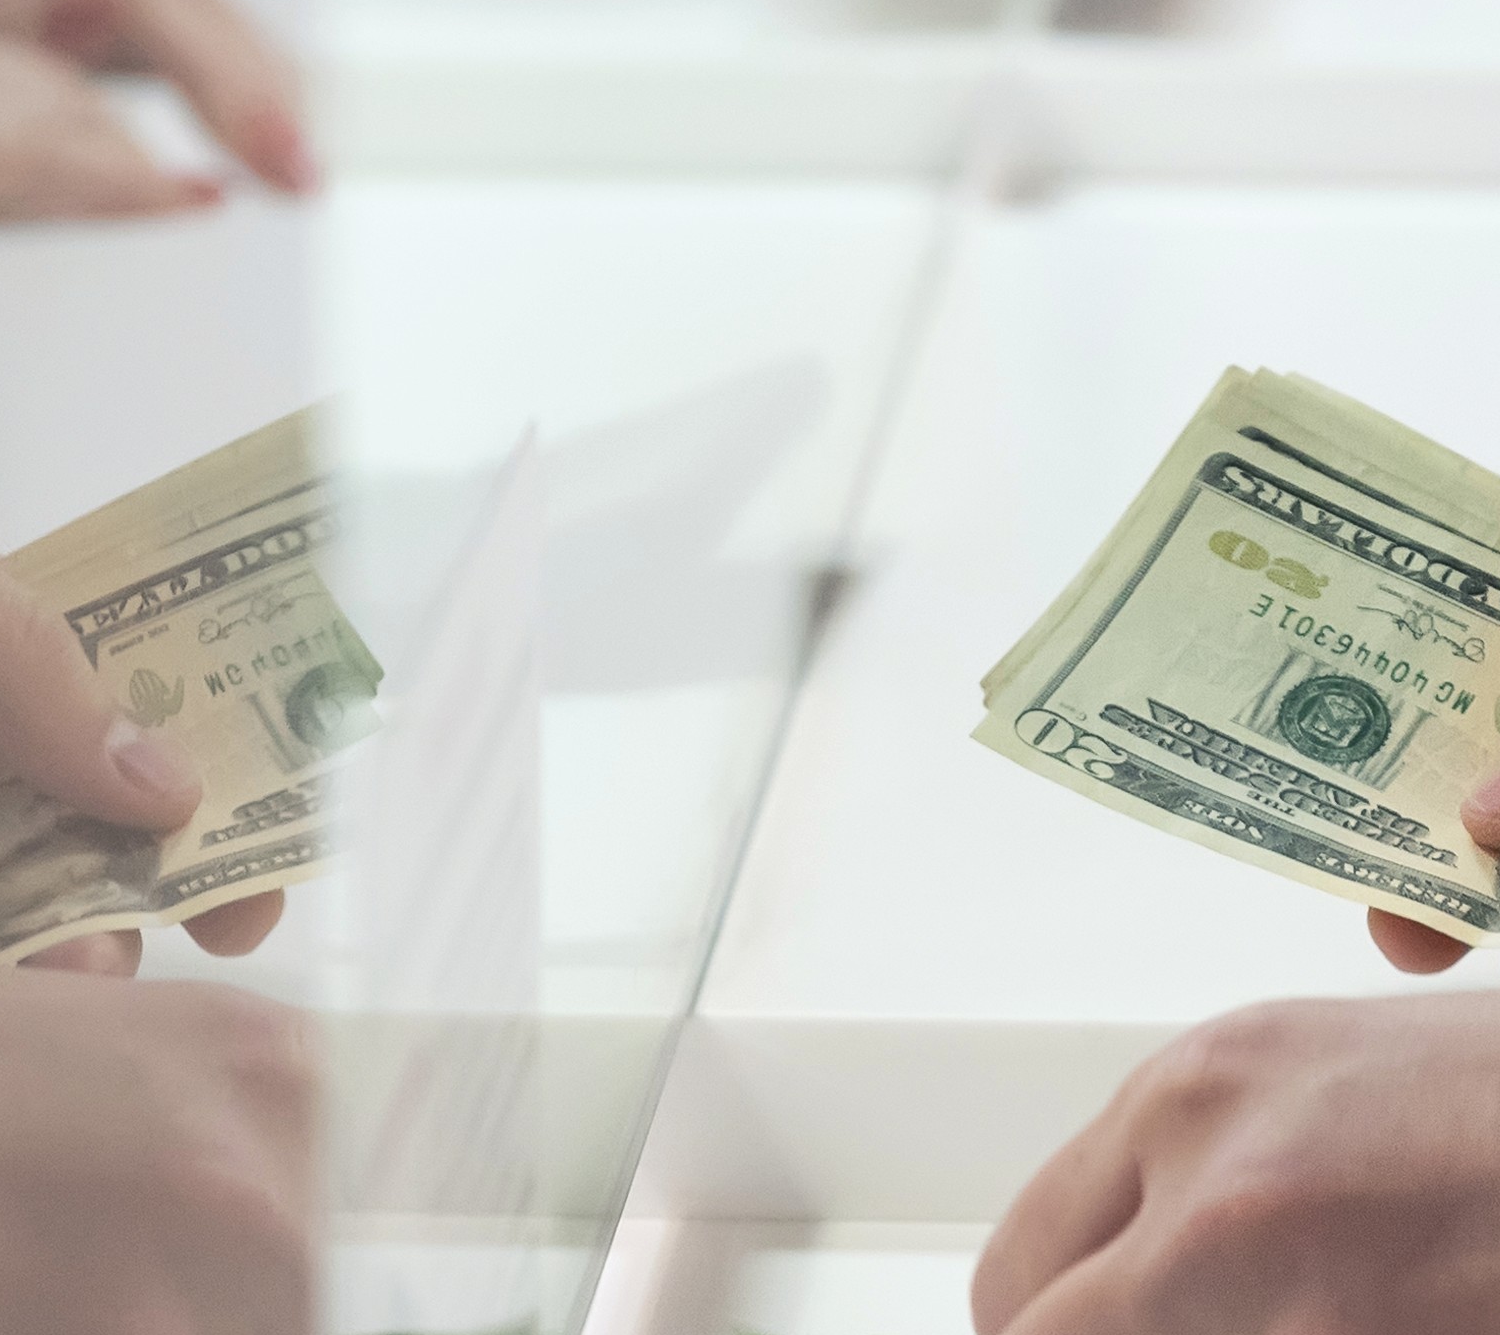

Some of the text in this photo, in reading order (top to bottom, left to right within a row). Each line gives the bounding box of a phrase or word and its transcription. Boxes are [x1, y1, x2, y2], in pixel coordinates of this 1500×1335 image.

[1218, 466, 1467, 591] DOLLARS
[1206, 530, 1331, 601] 20
[1013, 712, 1129, 778] 20
